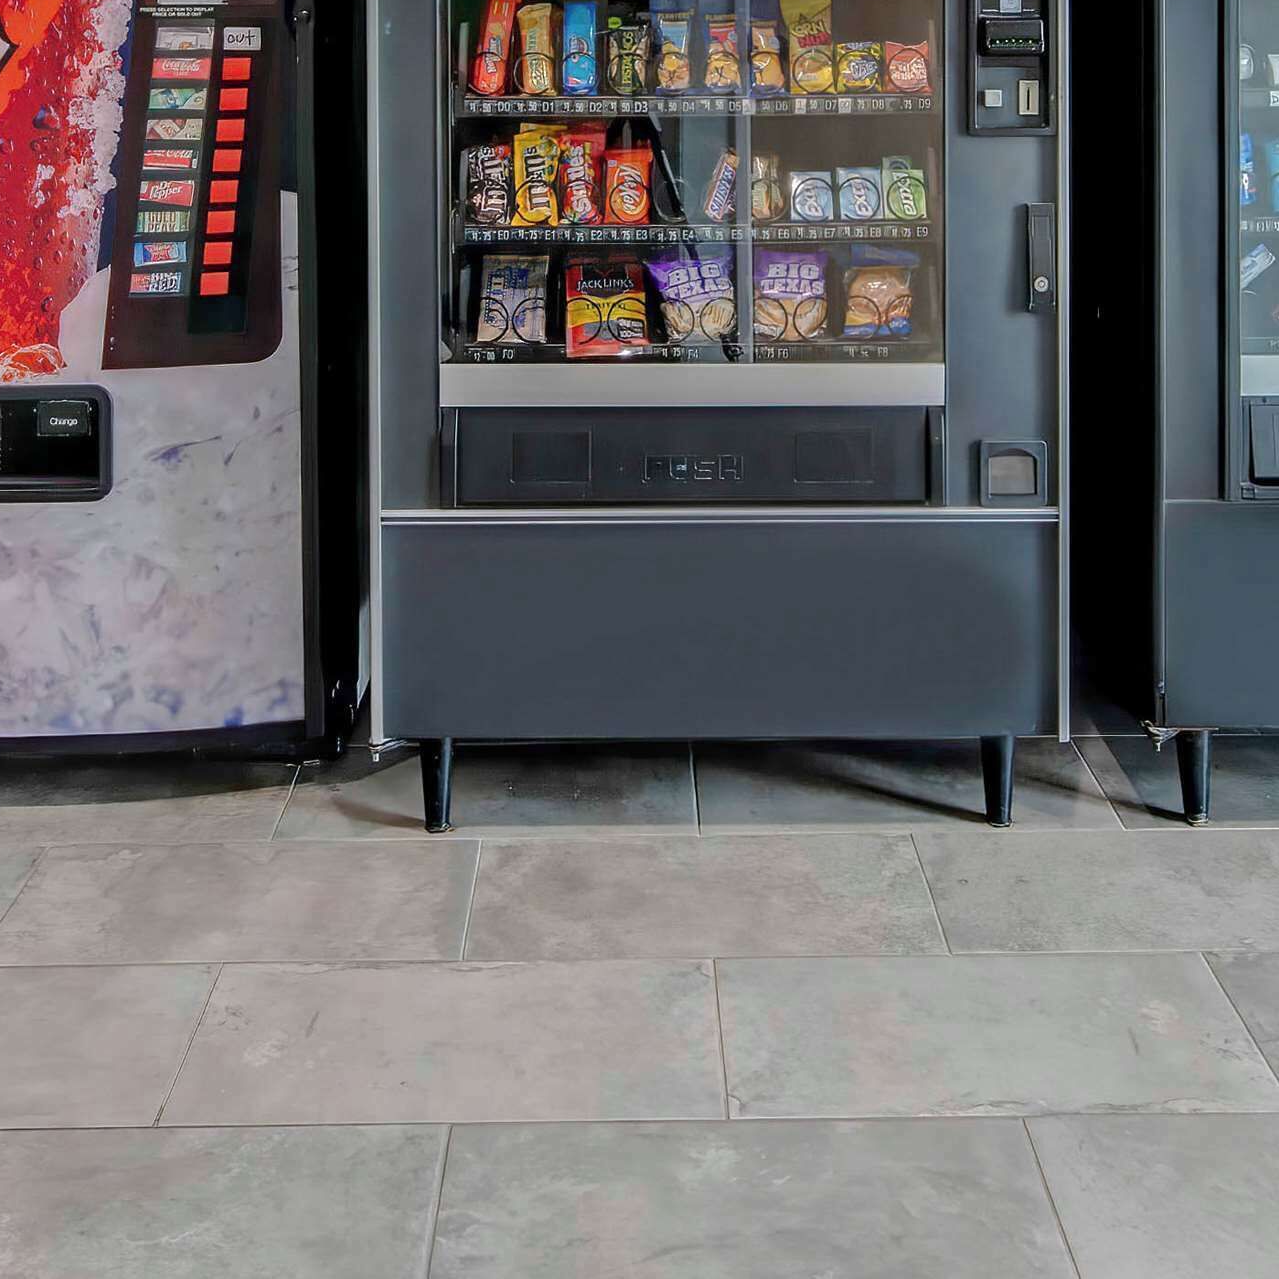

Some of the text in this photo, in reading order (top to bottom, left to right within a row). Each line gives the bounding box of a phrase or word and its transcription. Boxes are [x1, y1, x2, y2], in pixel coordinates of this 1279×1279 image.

[542, 102, 554, 112] D1
[589, 101, 602, 112] D2
[634, 101, 648, 112] D3
[682, 101, 695, 112] D4
[498, 230, 510, 240] E0
[545, 230, 555, 240] E1
[591, 230, 603, 240] E2
[636, 230, 648, 240] E3
[682, 230, 694, 239] E4
[731, 229, 743, 240] E5
[778, 228, 790, 239] E6
[824, 228, 836, 238] E7
[870, 227, 881, 238] E8
[917, 226, 928, 237] E9
[768, 263, 820, 280] BIG
[577, 279, 604, 290] JACK
[760, 279, 825, 296] TEXAS
[777, 348, 789, 359] F6
[50, 417, 77, 427] Change
